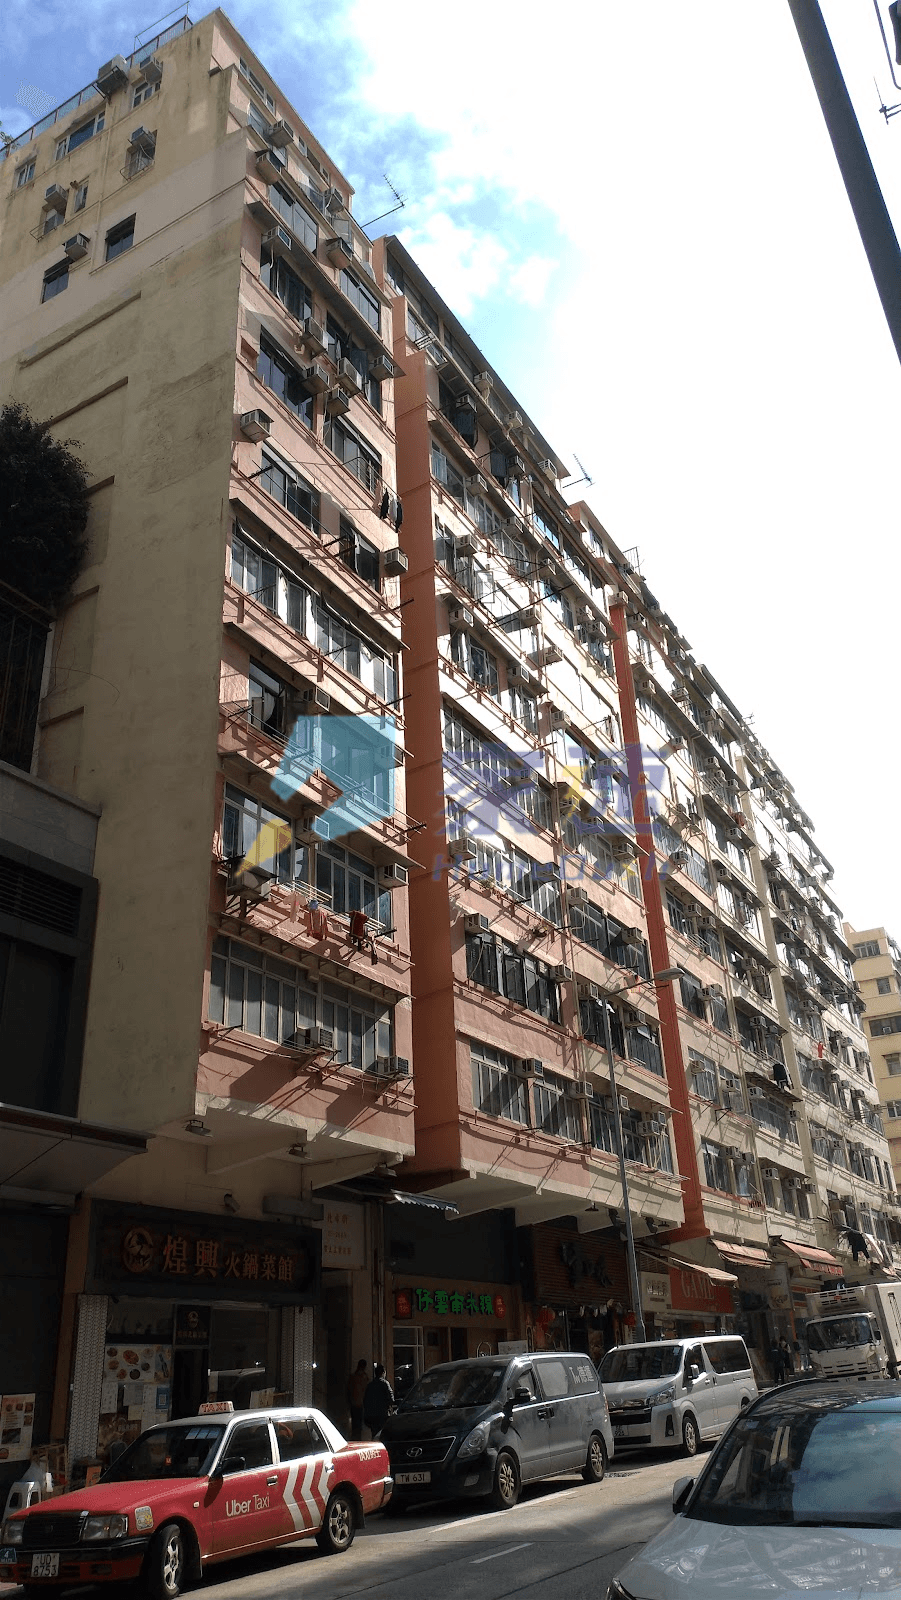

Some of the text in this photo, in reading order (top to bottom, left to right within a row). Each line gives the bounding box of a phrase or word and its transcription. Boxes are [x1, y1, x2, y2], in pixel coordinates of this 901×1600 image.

[202, 1402, 226, 1413] TAXI
[412, 1474, 425, 1482] 631
[225, 1492, 269, 1517] Uber Taxi
[33, 1565, 57, 1577] 8753
